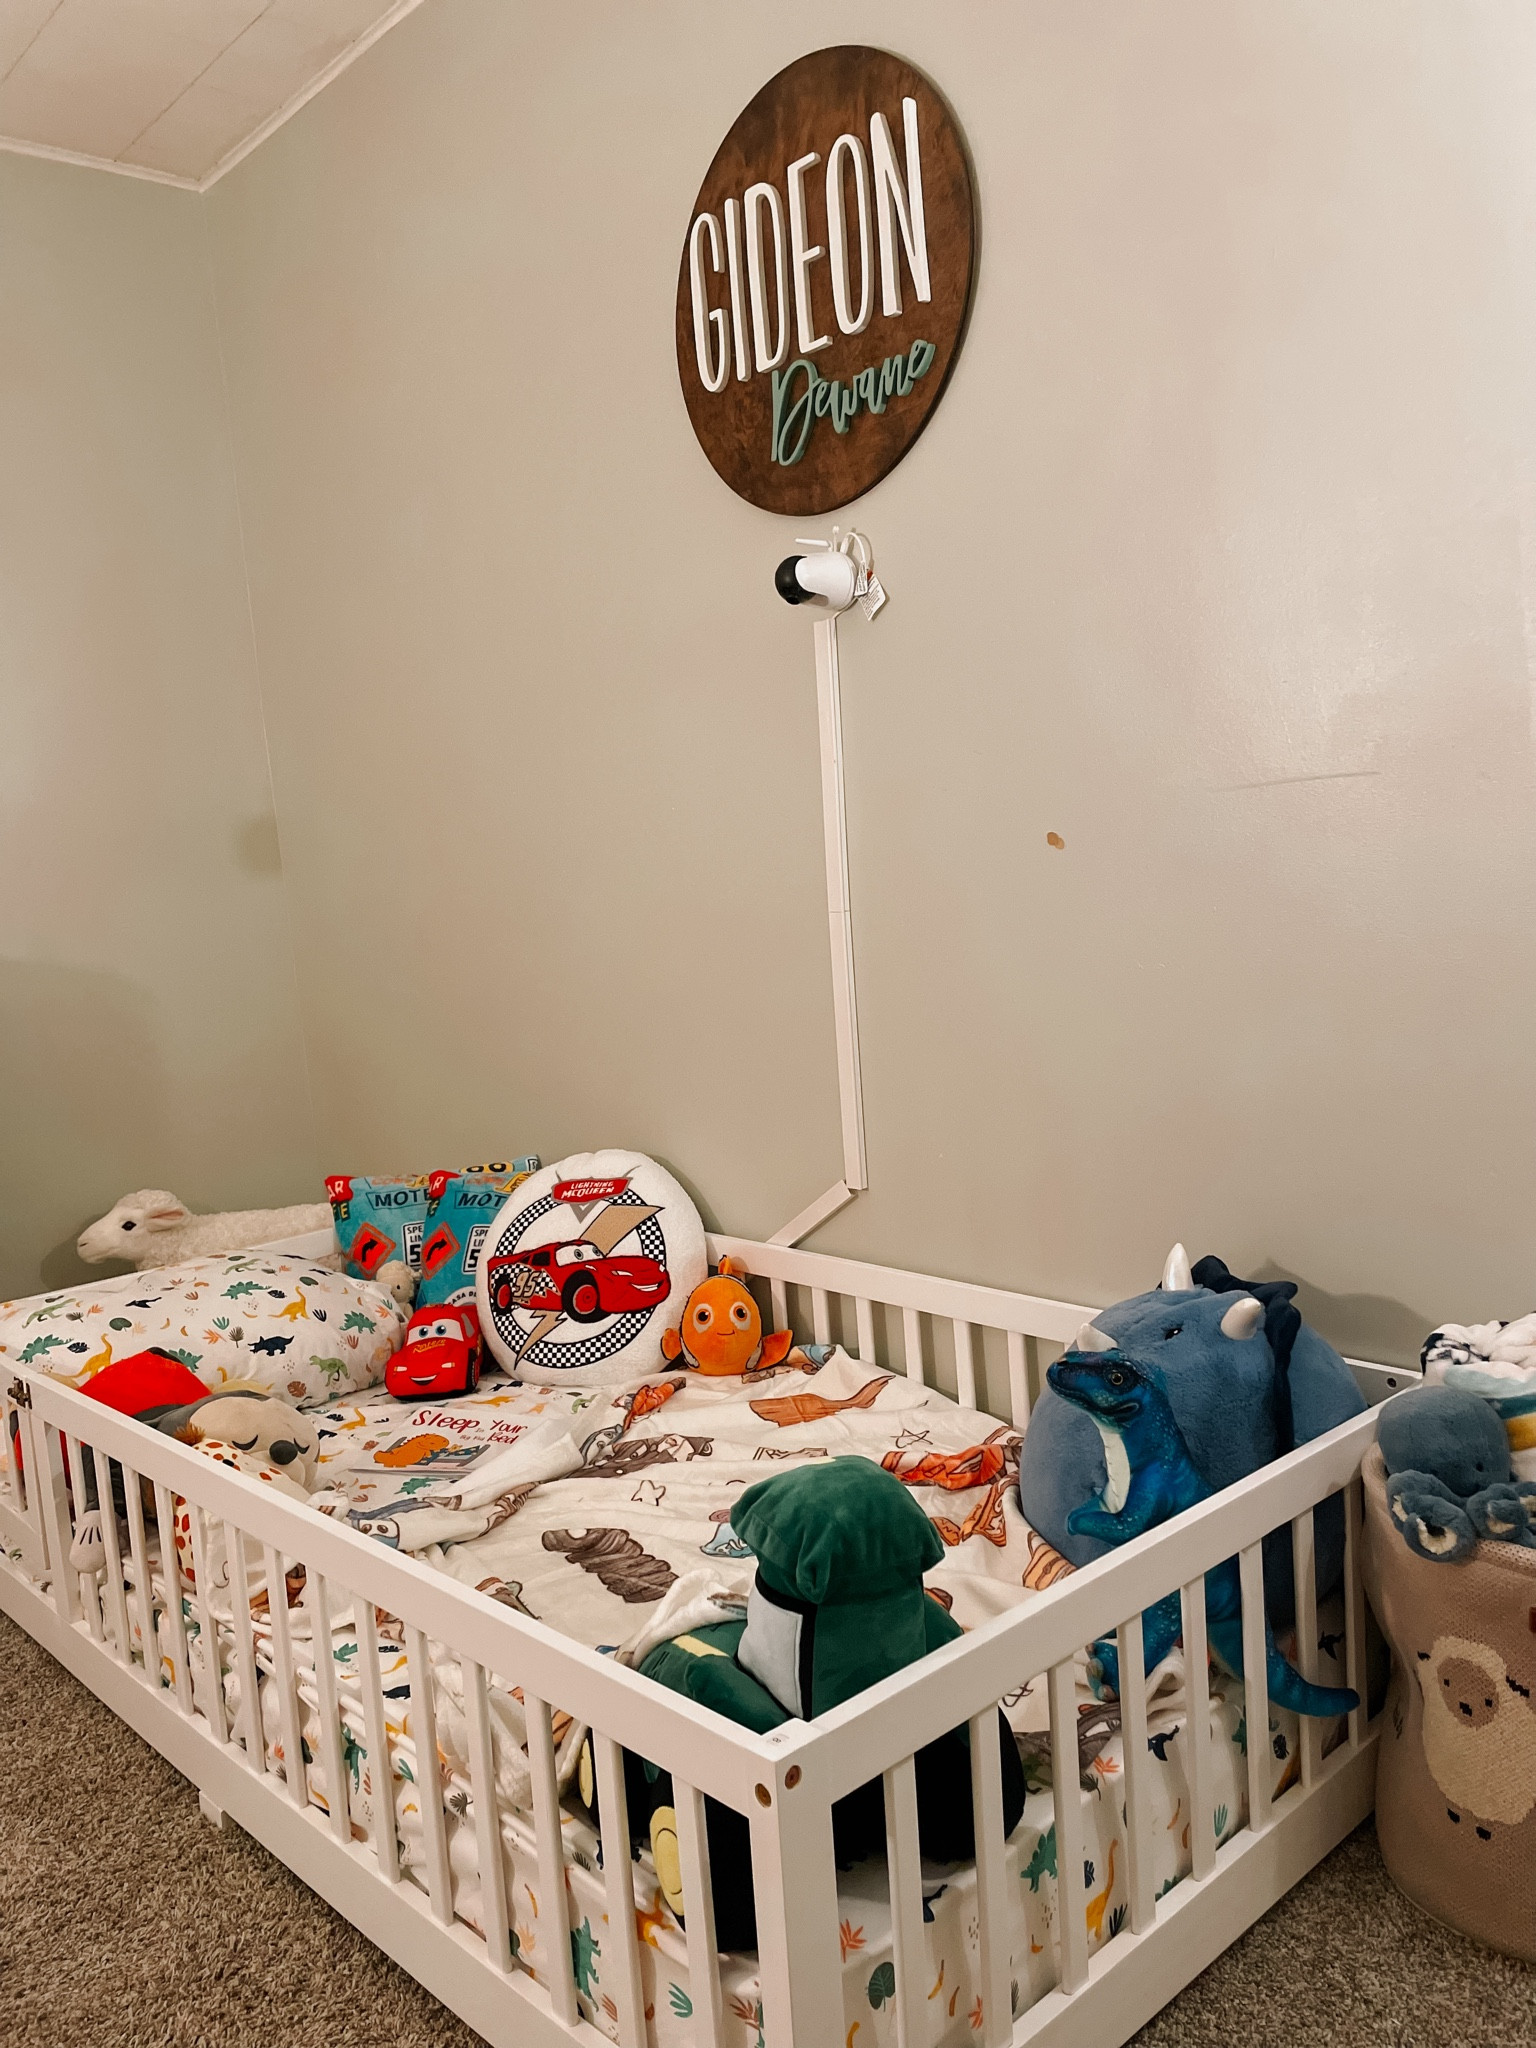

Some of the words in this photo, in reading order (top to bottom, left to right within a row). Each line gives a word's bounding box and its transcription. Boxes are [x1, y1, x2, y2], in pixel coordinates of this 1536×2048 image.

[689, 96, 931, 394] GIDEON
[771, 339, 936, 467] Dewane
[571, 1181, 614, 1190] LIGHTNING
[457, 1193, 509, 1207] MOT
[407, 1225, 423, 1234] SPE
[410, 1244, 421, 1263] 5
[513, 1271, 542, 1298] 95
[412, 1410, 480, 1433] Sleep
[489, 1419, 529, 1433] Your
[486, 1431, 519, 1444] Bed
